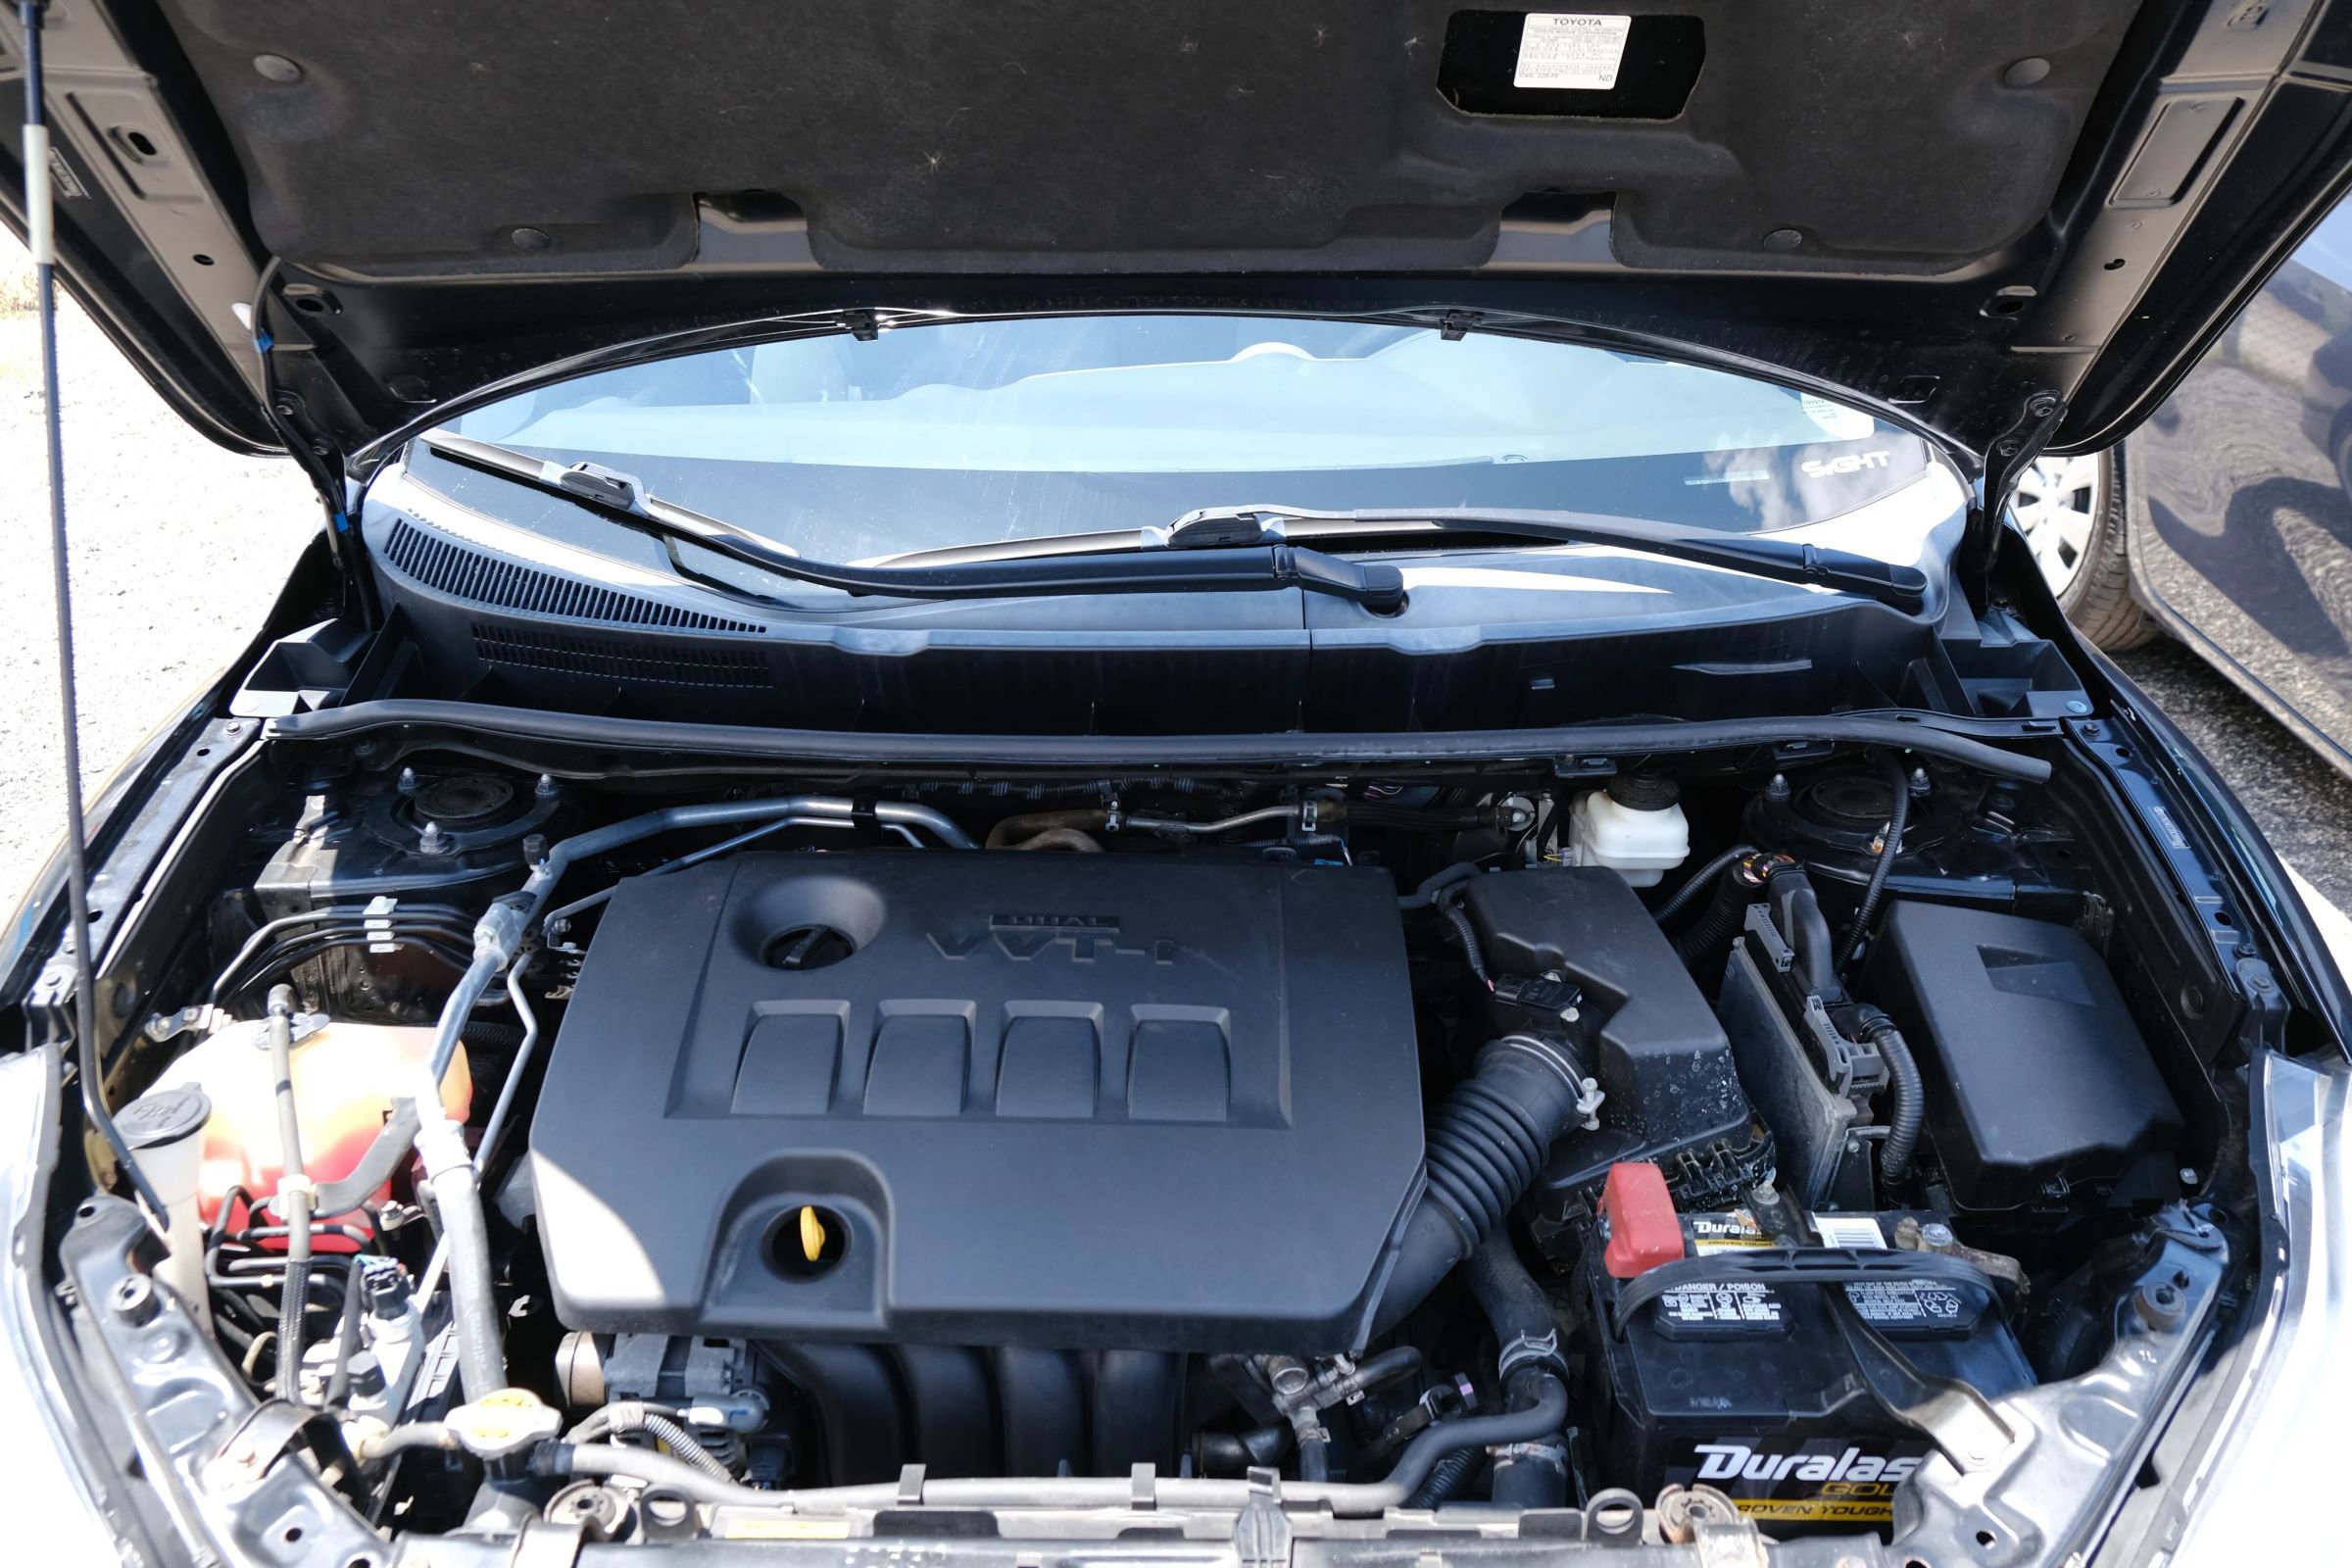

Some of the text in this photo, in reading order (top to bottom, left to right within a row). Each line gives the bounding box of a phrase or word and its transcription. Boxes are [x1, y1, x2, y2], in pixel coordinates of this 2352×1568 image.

[1553, 18, 1602, 26] TOYOTA
[1727, 1283, 1766, 1292] POISON
[1694, 1445, 1924, 1482] Duralas
[1821, 1483, 1895, 1496] GOL
[1738, 1504, 1813, 1516] ROVEN
